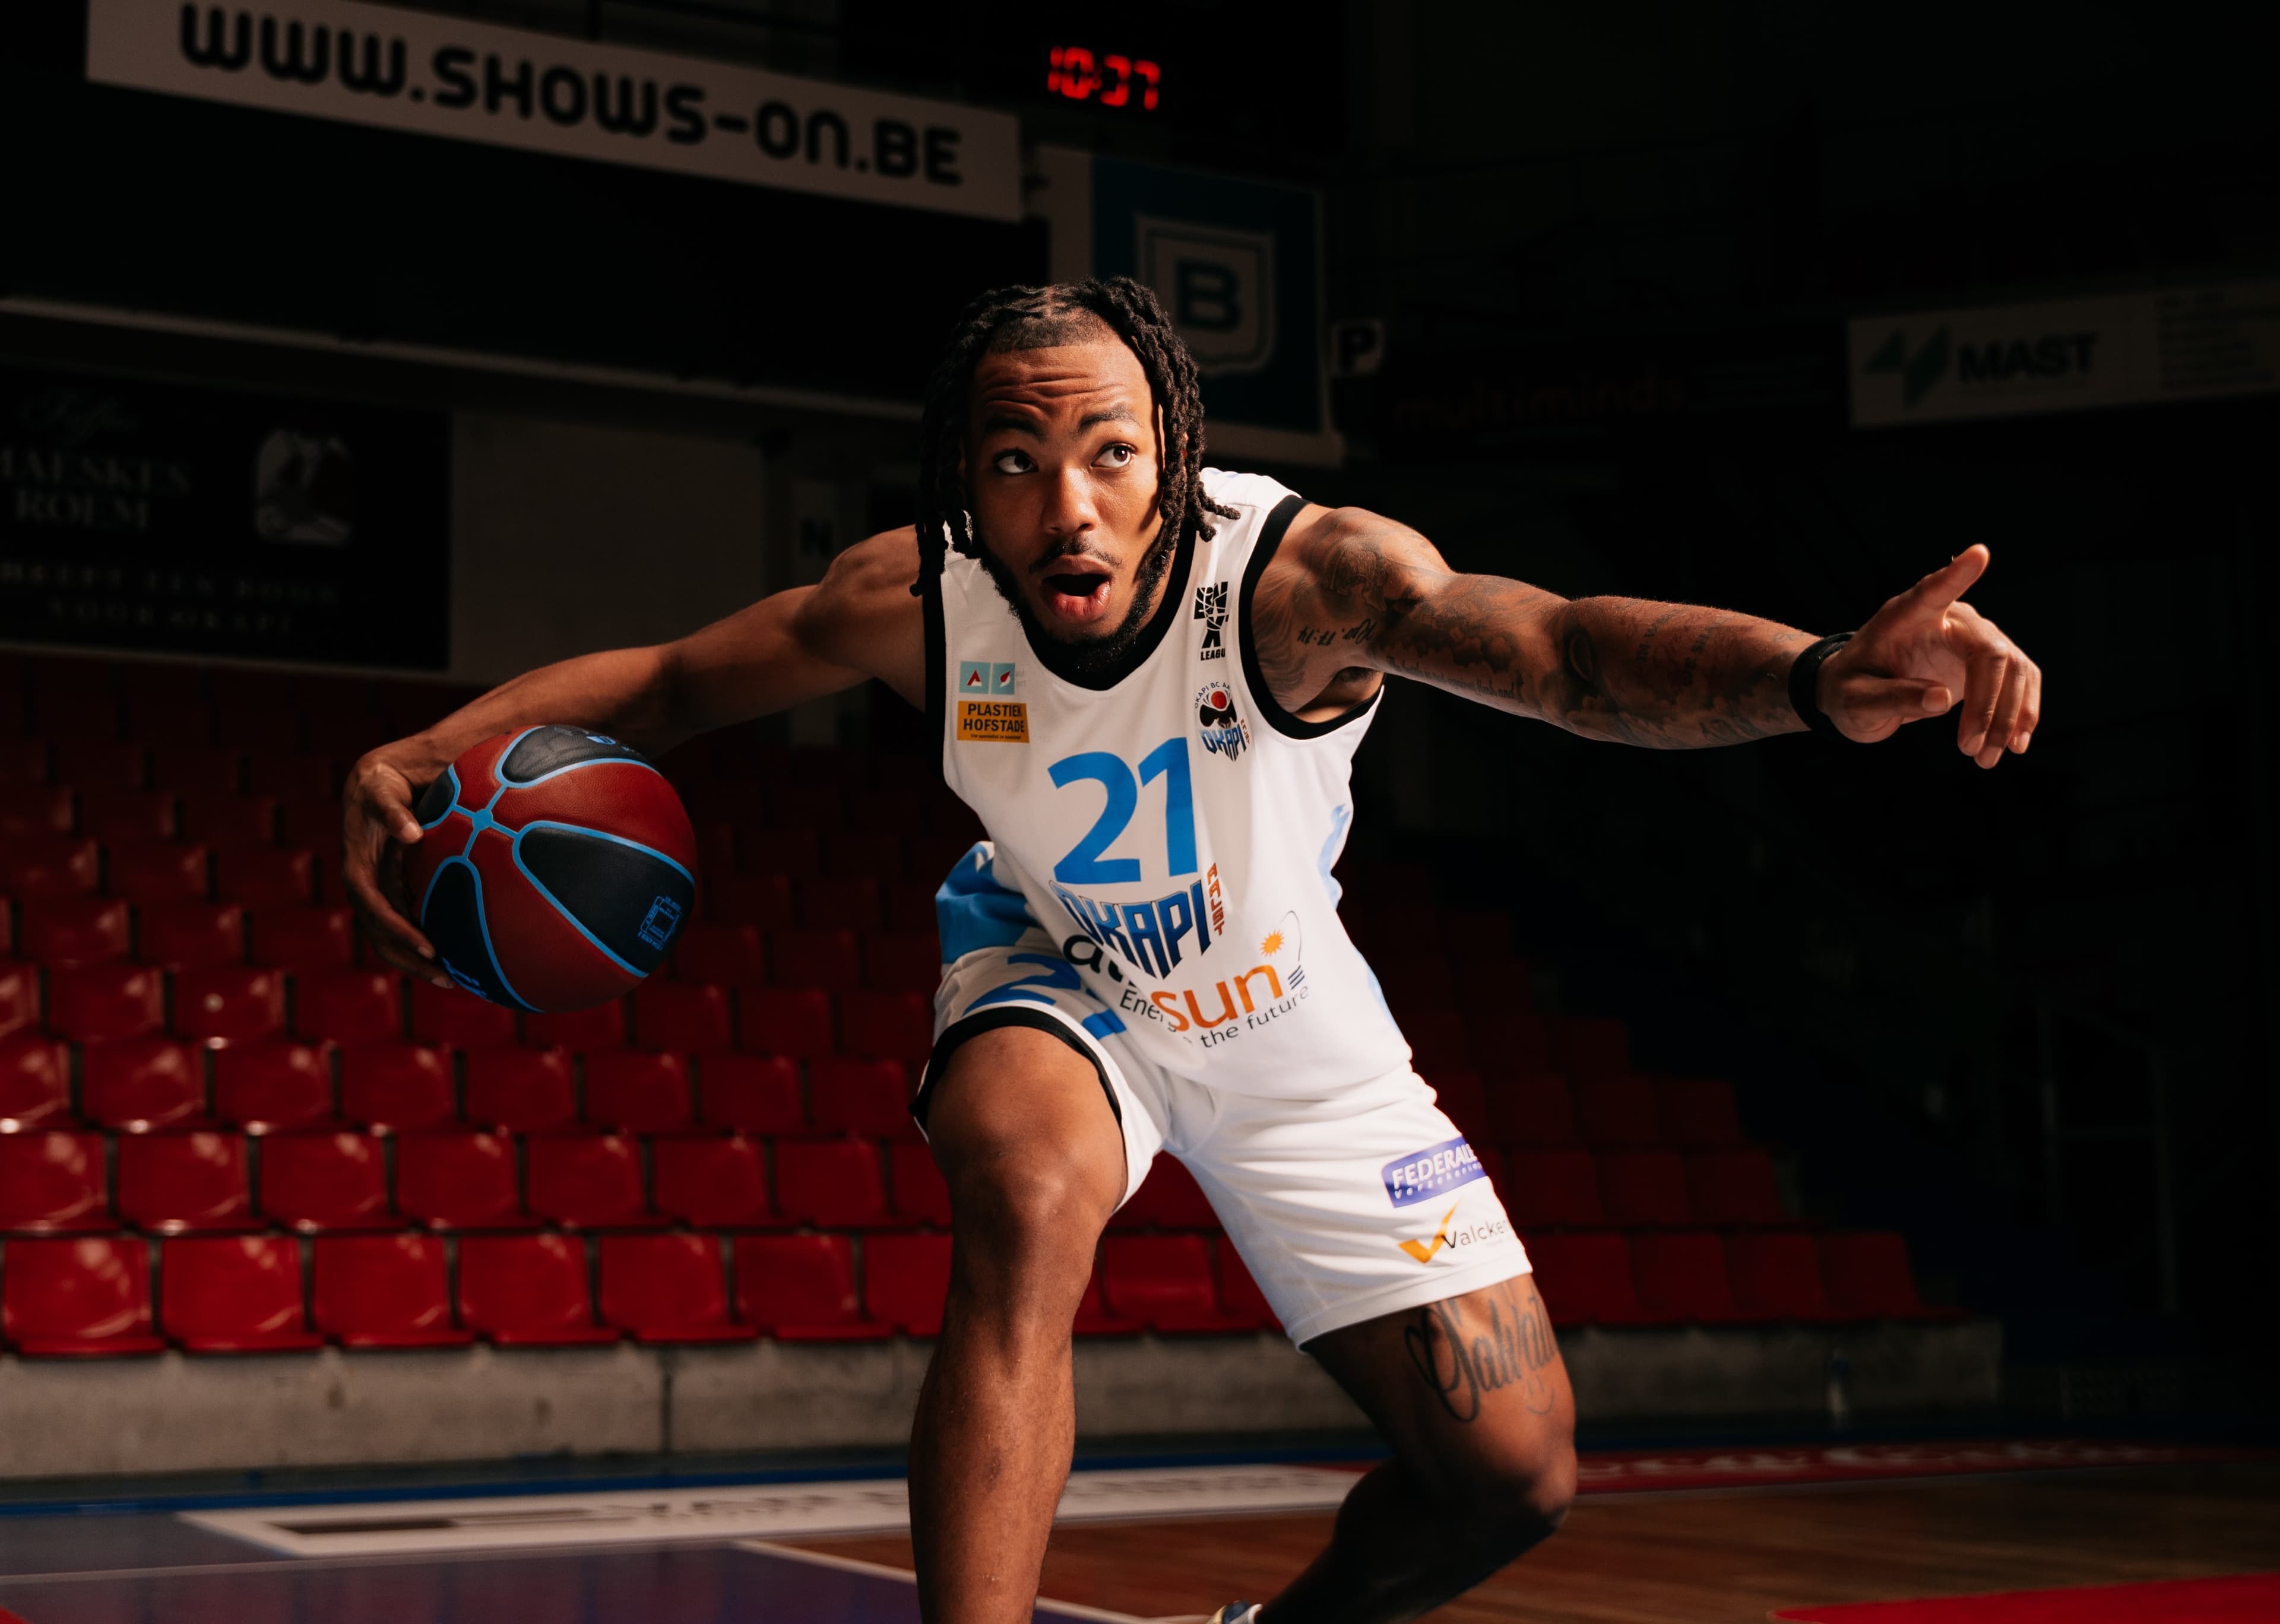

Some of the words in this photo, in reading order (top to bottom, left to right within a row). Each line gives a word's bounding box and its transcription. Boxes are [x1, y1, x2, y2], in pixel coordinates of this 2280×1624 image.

[1177, 260, 1238, 330] B
[1342, 327, 1371, 372] P
[1959, 331, 2100, 383] MAST
[14, 488, 151, 533] ROEM
[1200, 648, 1226, 661] LEAGU
[1195, 684, 1210, 709] OKAPI
[1210, 681, 1221, 689] BC
[963, 718, 1025, 733] HOFSTADE
[1047, 737, 1198, 884] 21
[1200, 1024, 1239, 1049] the
[1246, 985, 1310, 1031] future
